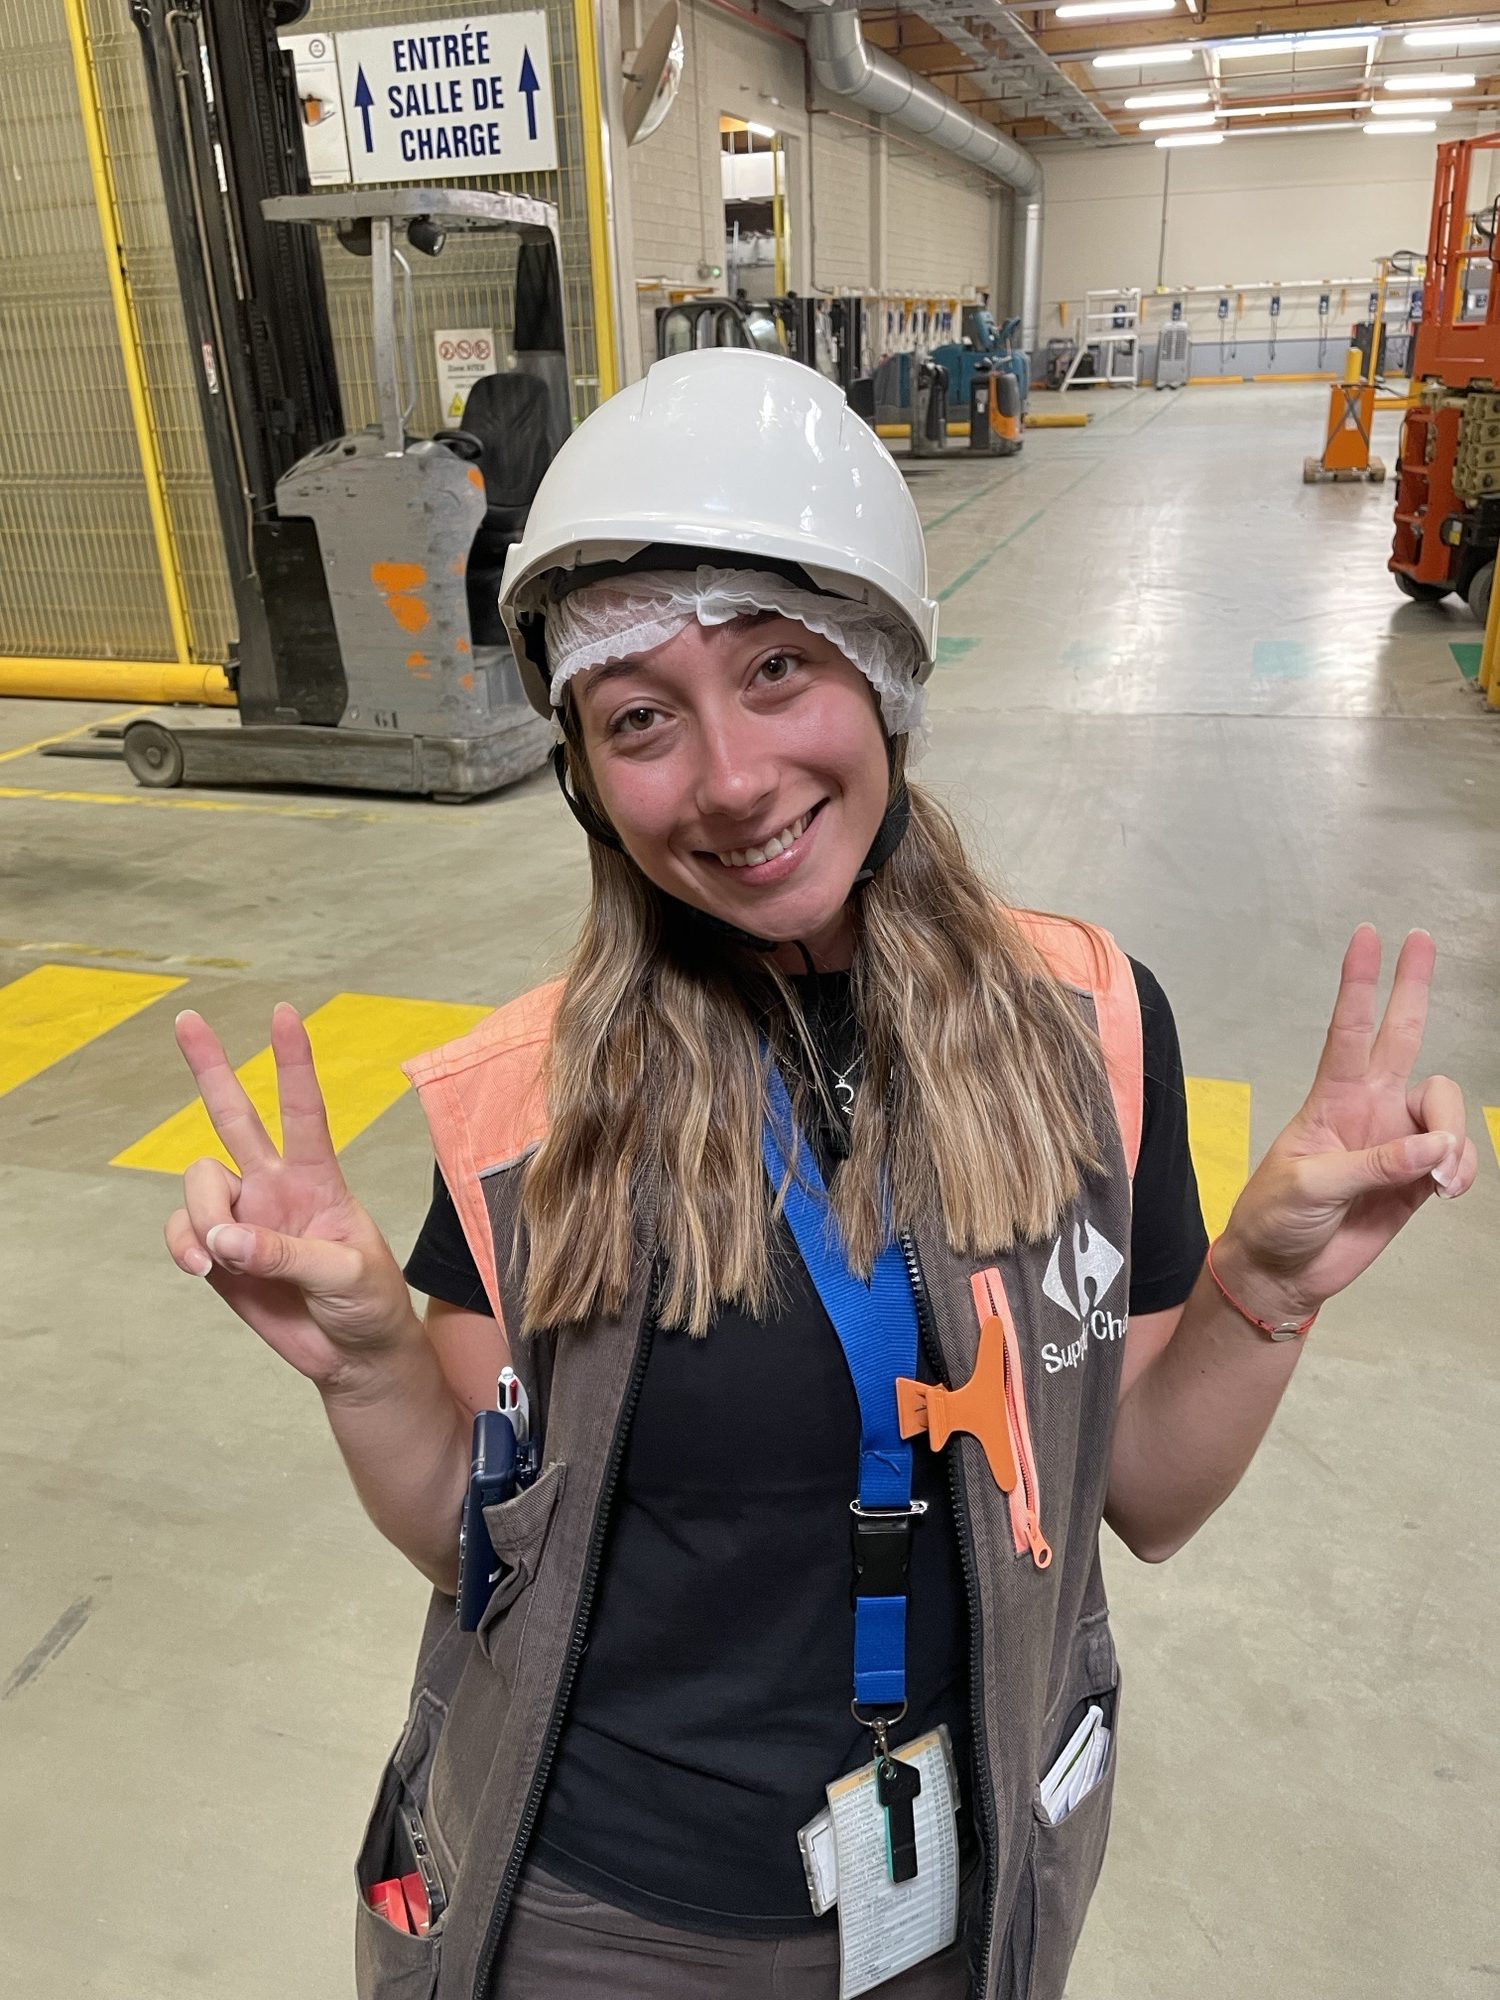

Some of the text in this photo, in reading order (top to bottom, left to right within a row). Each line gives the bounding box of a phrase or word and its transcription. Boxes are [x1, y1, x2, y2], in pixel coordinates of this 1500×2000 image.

[392, 24, 490, 73] ENTRÉE
[387, 76, 504, 119] SALLE DE
[400, 122, 501, 162] CHARGE
[1041, 1321, 1089, 1374] Supp
